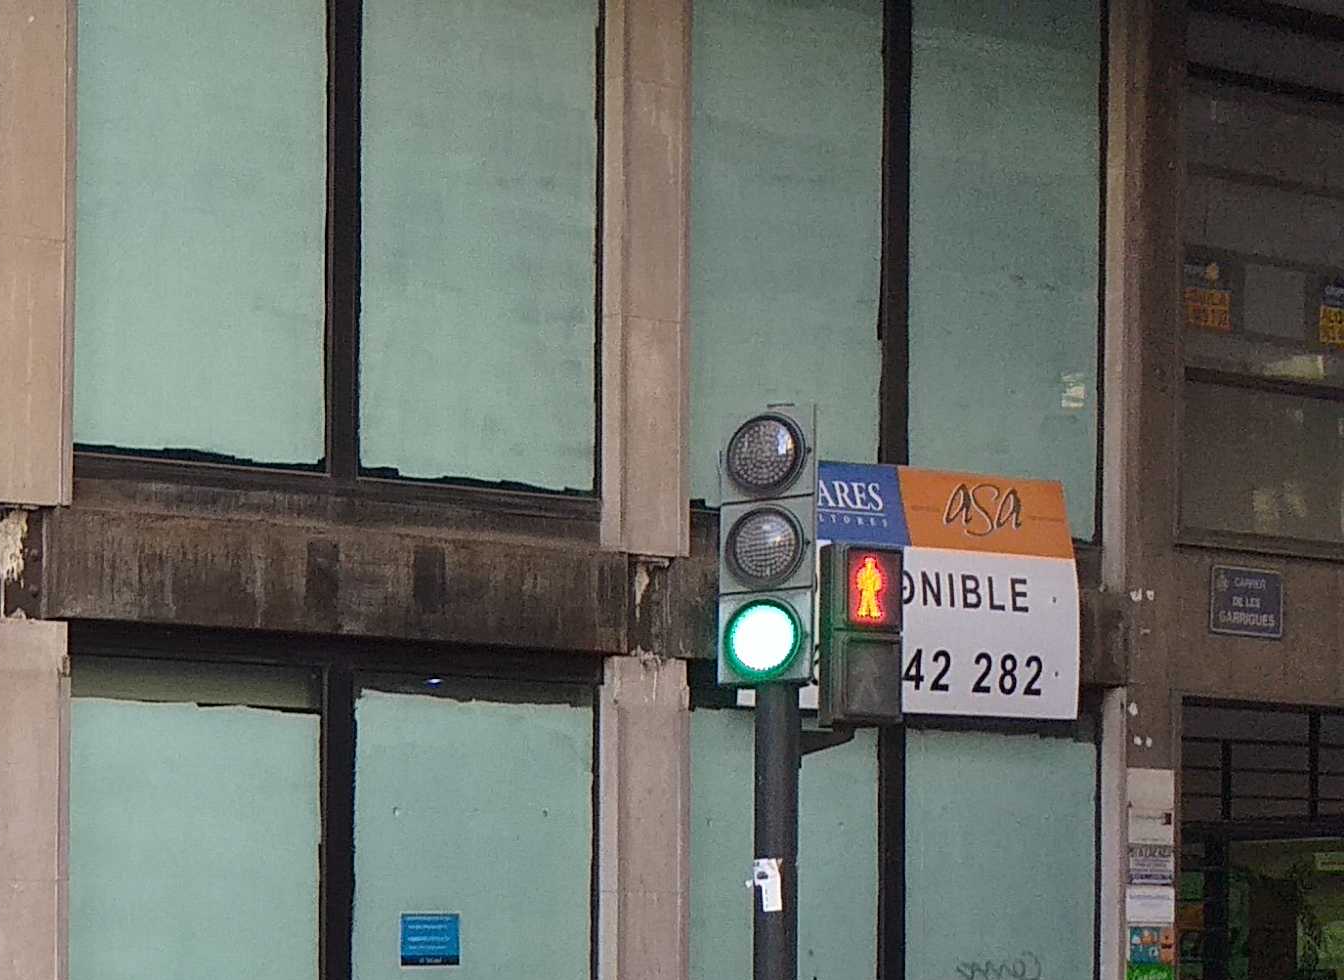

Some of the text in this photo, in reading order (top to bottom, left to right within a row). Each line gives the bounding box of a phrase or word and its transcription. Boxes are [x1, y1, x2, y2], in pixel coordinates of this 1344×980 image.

[818, 480, 883, 512] ARES
[819, 514, 889, 529] LTORES
[903, 570, 1029, 614] ONIBLE
[904, 648, 1043, 697] 42 282
